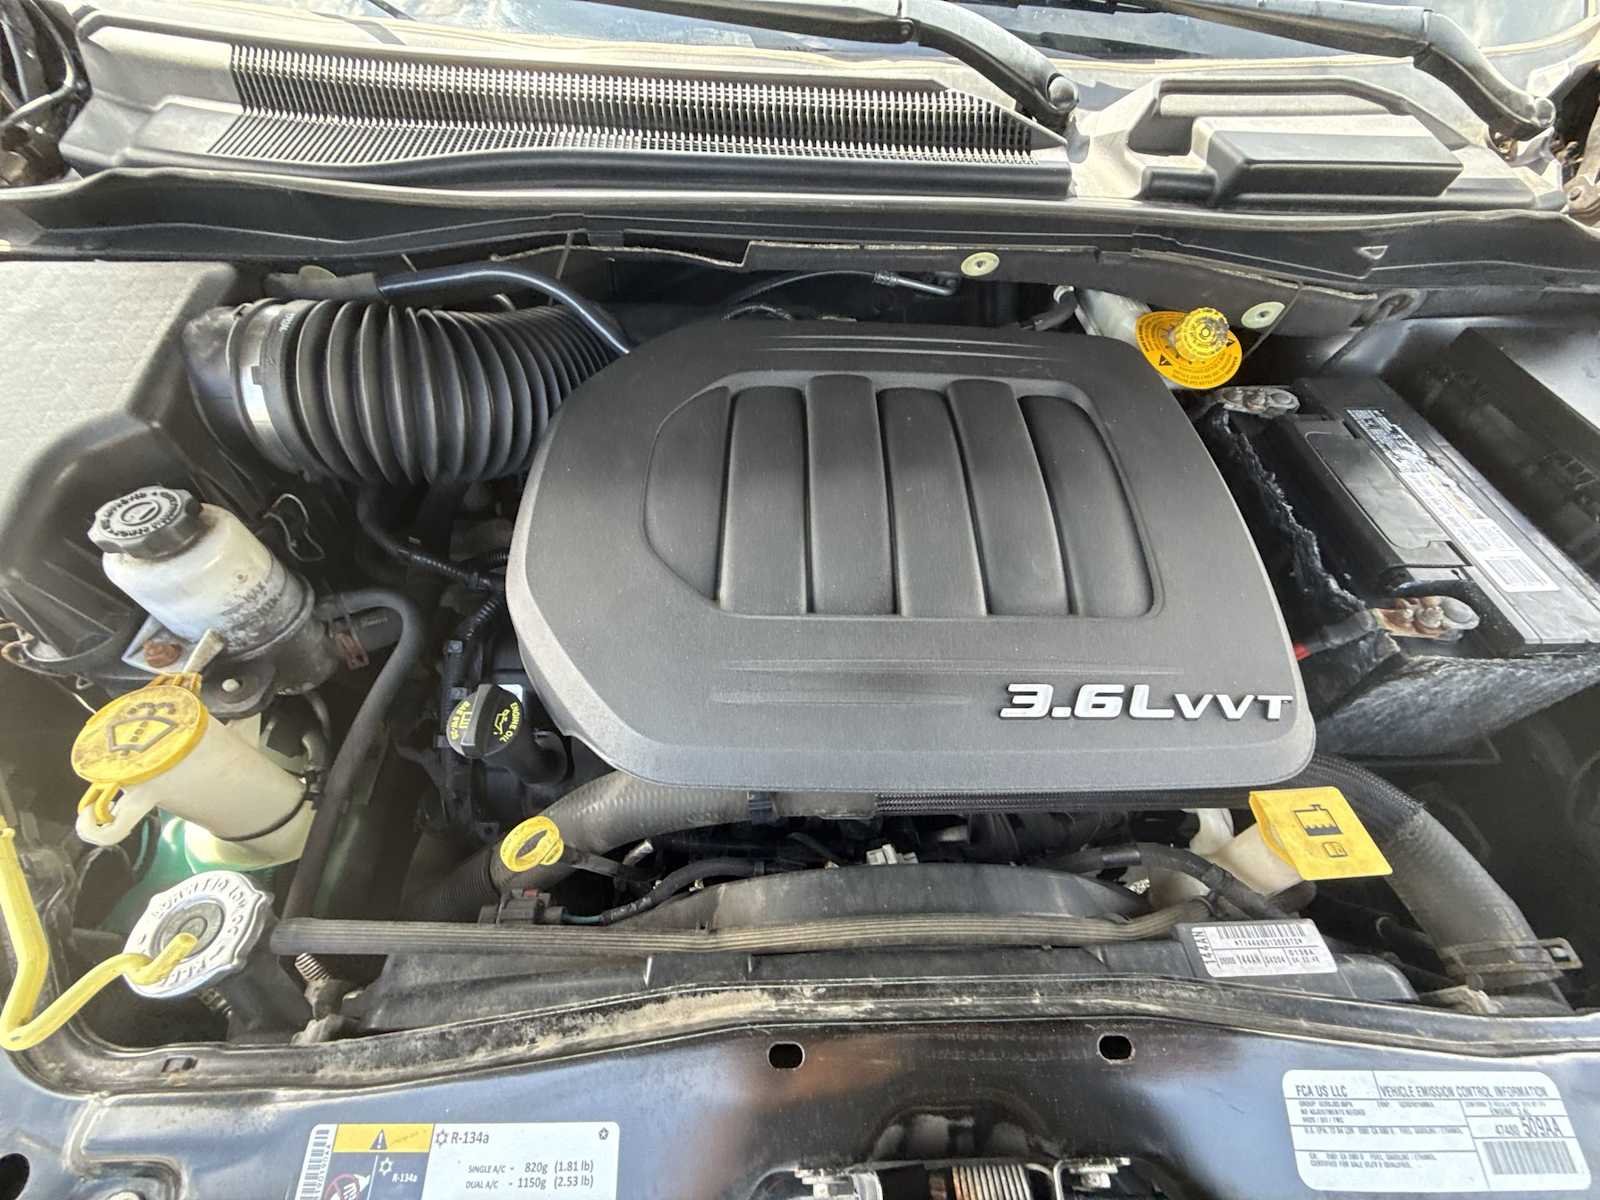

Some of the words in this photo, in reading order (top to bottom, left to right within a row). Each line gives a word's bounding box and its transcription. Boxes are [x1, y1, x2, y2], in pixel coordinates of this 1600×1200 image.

[499, 730, 514, 743] OIL
[1296, 1084, 1314, 1097] FCA
[1314, 1084, 1330, 1097] US
[1330, 1084, 1348, 1097] LLC
[1456, 1086, 1493, 1098] CONTROL
[451, 1131, 490, 1145] R-134a
[468, 1165, 494, 1175] SINGLE
[494, 1164, 506, 1174] A/C
[524, 1162, 548, 1175] 820g
[553, 1160, 578, 1174] (1.81
[580, 1160, 594, 1173] lb)
[465, 1180, 484, 1190] DUAL
[485, 1179, 499, 1190] A/C
[517, 1178, 547, 1190] 1150g
[553, 1176, 578, 1189] (2.53
[580, 1175, 594, 1188] lb)
